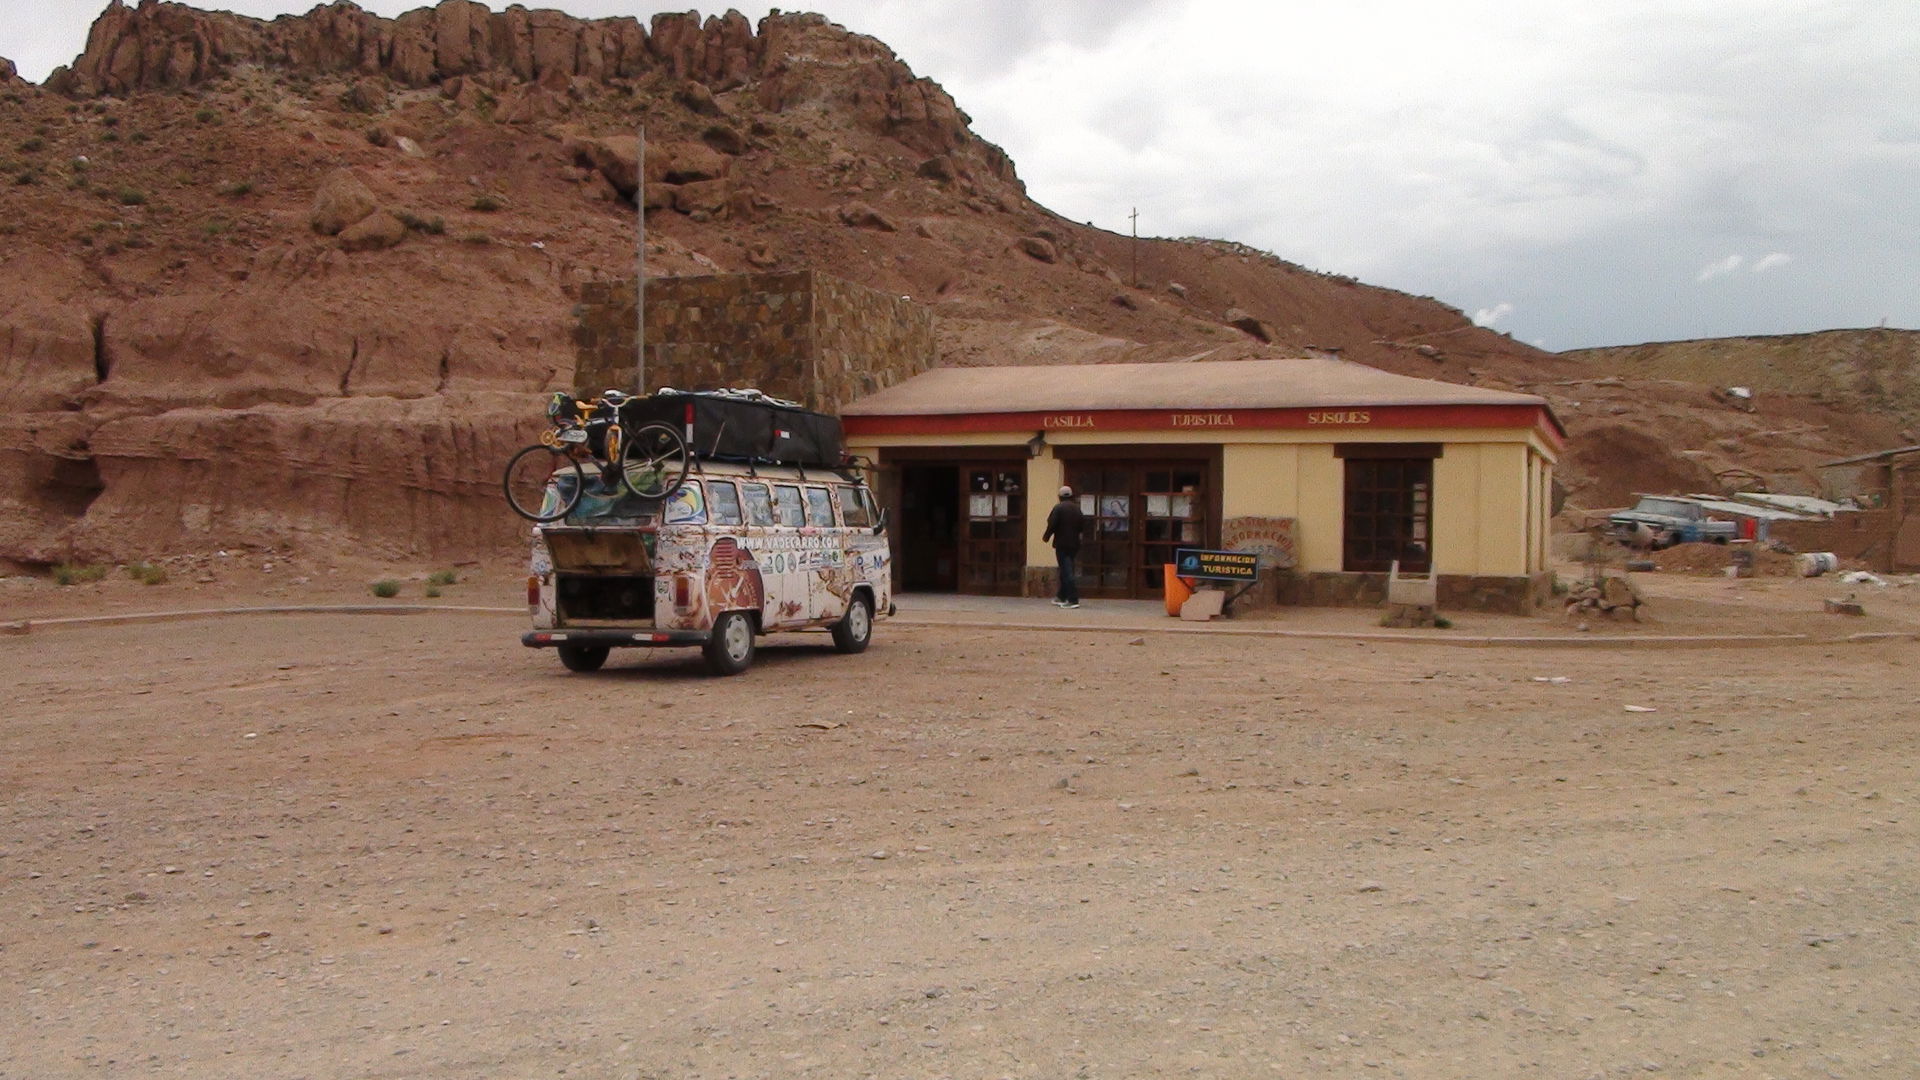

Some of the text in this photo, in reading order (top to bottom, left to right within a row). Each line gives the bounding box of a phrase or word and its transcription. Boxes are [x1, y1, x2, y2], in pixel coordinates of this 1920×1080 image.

[1043, 411, 1371, 428] CASILLA TURISTICA SUSQUES
[1200, 553, 1256, 564] INFORMACION
[1202, 565, 1253, 575] TURISTICA
